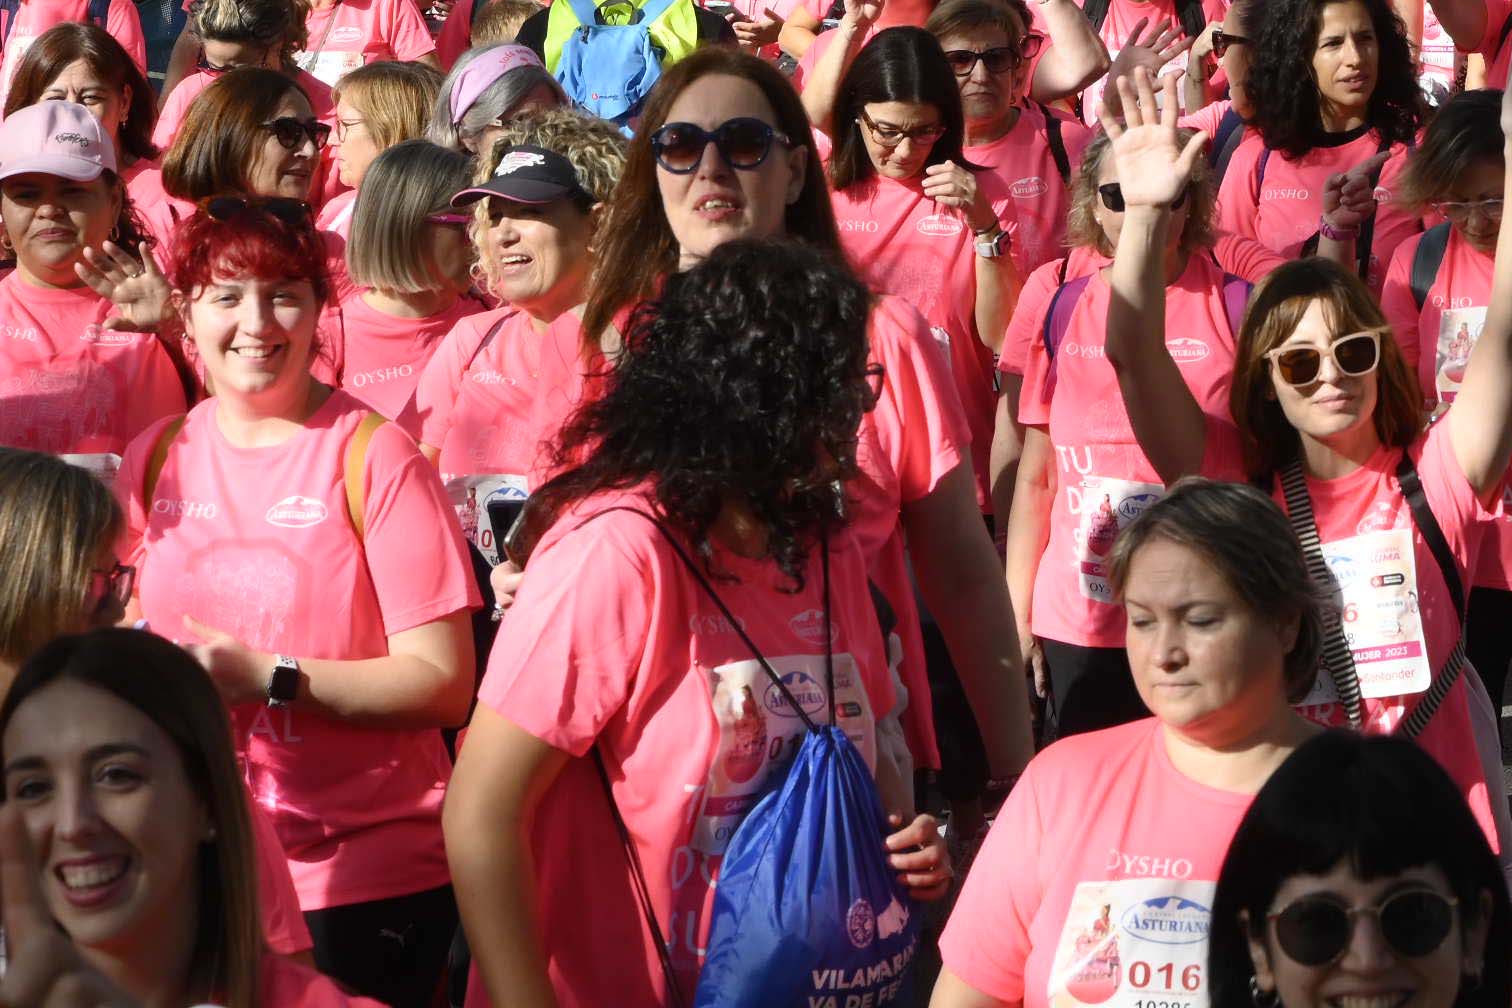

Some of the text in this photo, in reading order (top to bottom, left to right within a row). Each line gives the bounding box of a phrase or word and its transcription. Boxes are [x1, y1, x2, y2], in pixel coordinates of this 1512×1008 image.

[1265, 189, 1309, 201] OYSHO
[836, 220, 879, 233] YSHO
[1065, 342, 1105, 359] OYSH
[352, 364, 413, 387] OYSHO
[1055, 445, 1093, 475] TU
[1385, 646, 1408, 658] 2023
[1129, 914, 1210, 933] ASTURIAN
